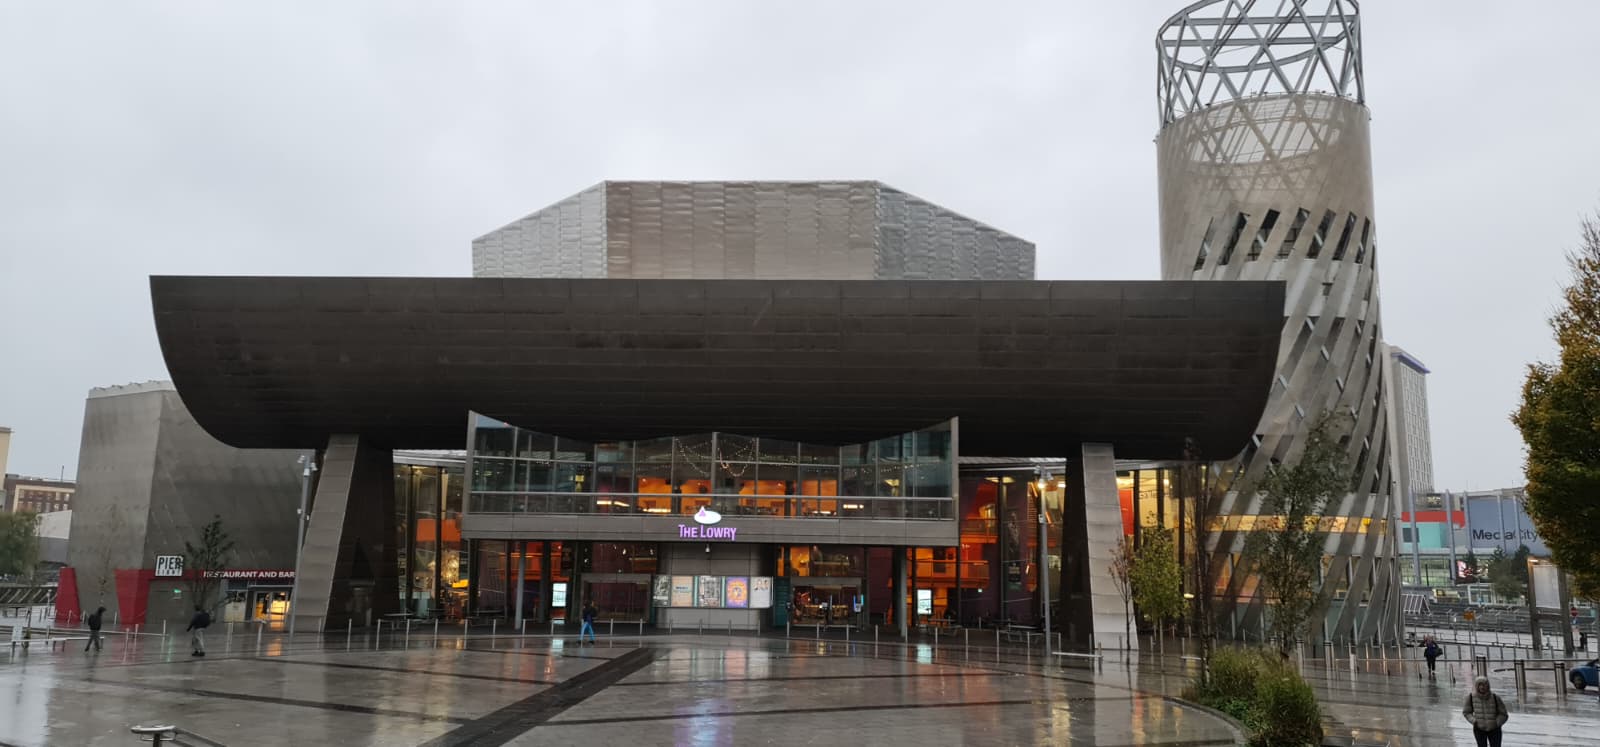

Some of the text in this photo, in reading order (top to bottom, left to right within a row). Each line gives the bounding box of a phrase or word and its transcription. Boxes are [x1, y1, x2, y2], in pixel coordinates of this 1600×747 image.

[678, 524, 737, 541] THE LOWRY
[158, 557, 182, 569] PIER
